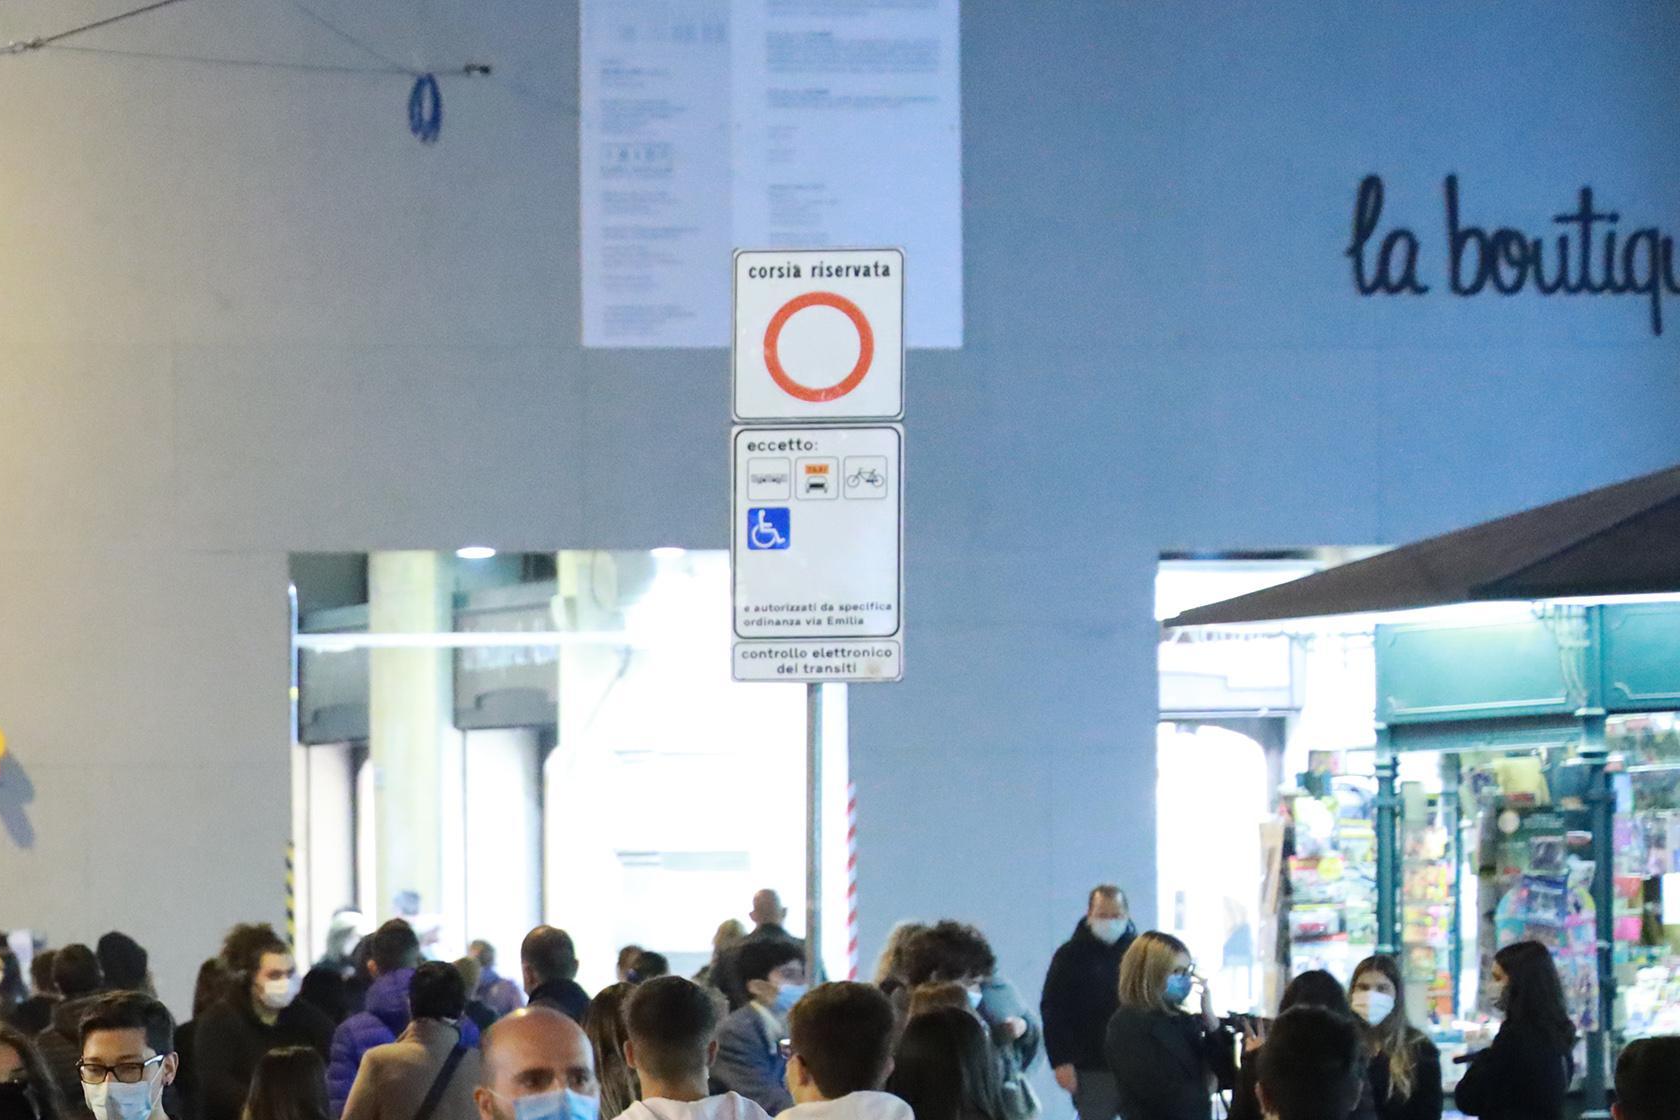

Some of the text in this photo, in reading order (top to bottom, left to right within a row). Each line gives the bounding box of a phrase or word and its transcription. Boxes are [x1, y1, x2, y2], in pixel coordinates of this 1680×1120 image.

[1344, 174, 1430, 296] la
[748, 261, 891, 279] corsia riservata
[747, 438, 818, 452] eccetto:
[753, 602, 817, 613] autorizzati
[820, 602, 834, 612] da
[839, 602, 892, 613] specifica
[743, 616, 864, 627] ordinanza via Emilia
[741, 646, 893, 660] controllo elettronico
[777, 662, 857, 674] dei transiti
